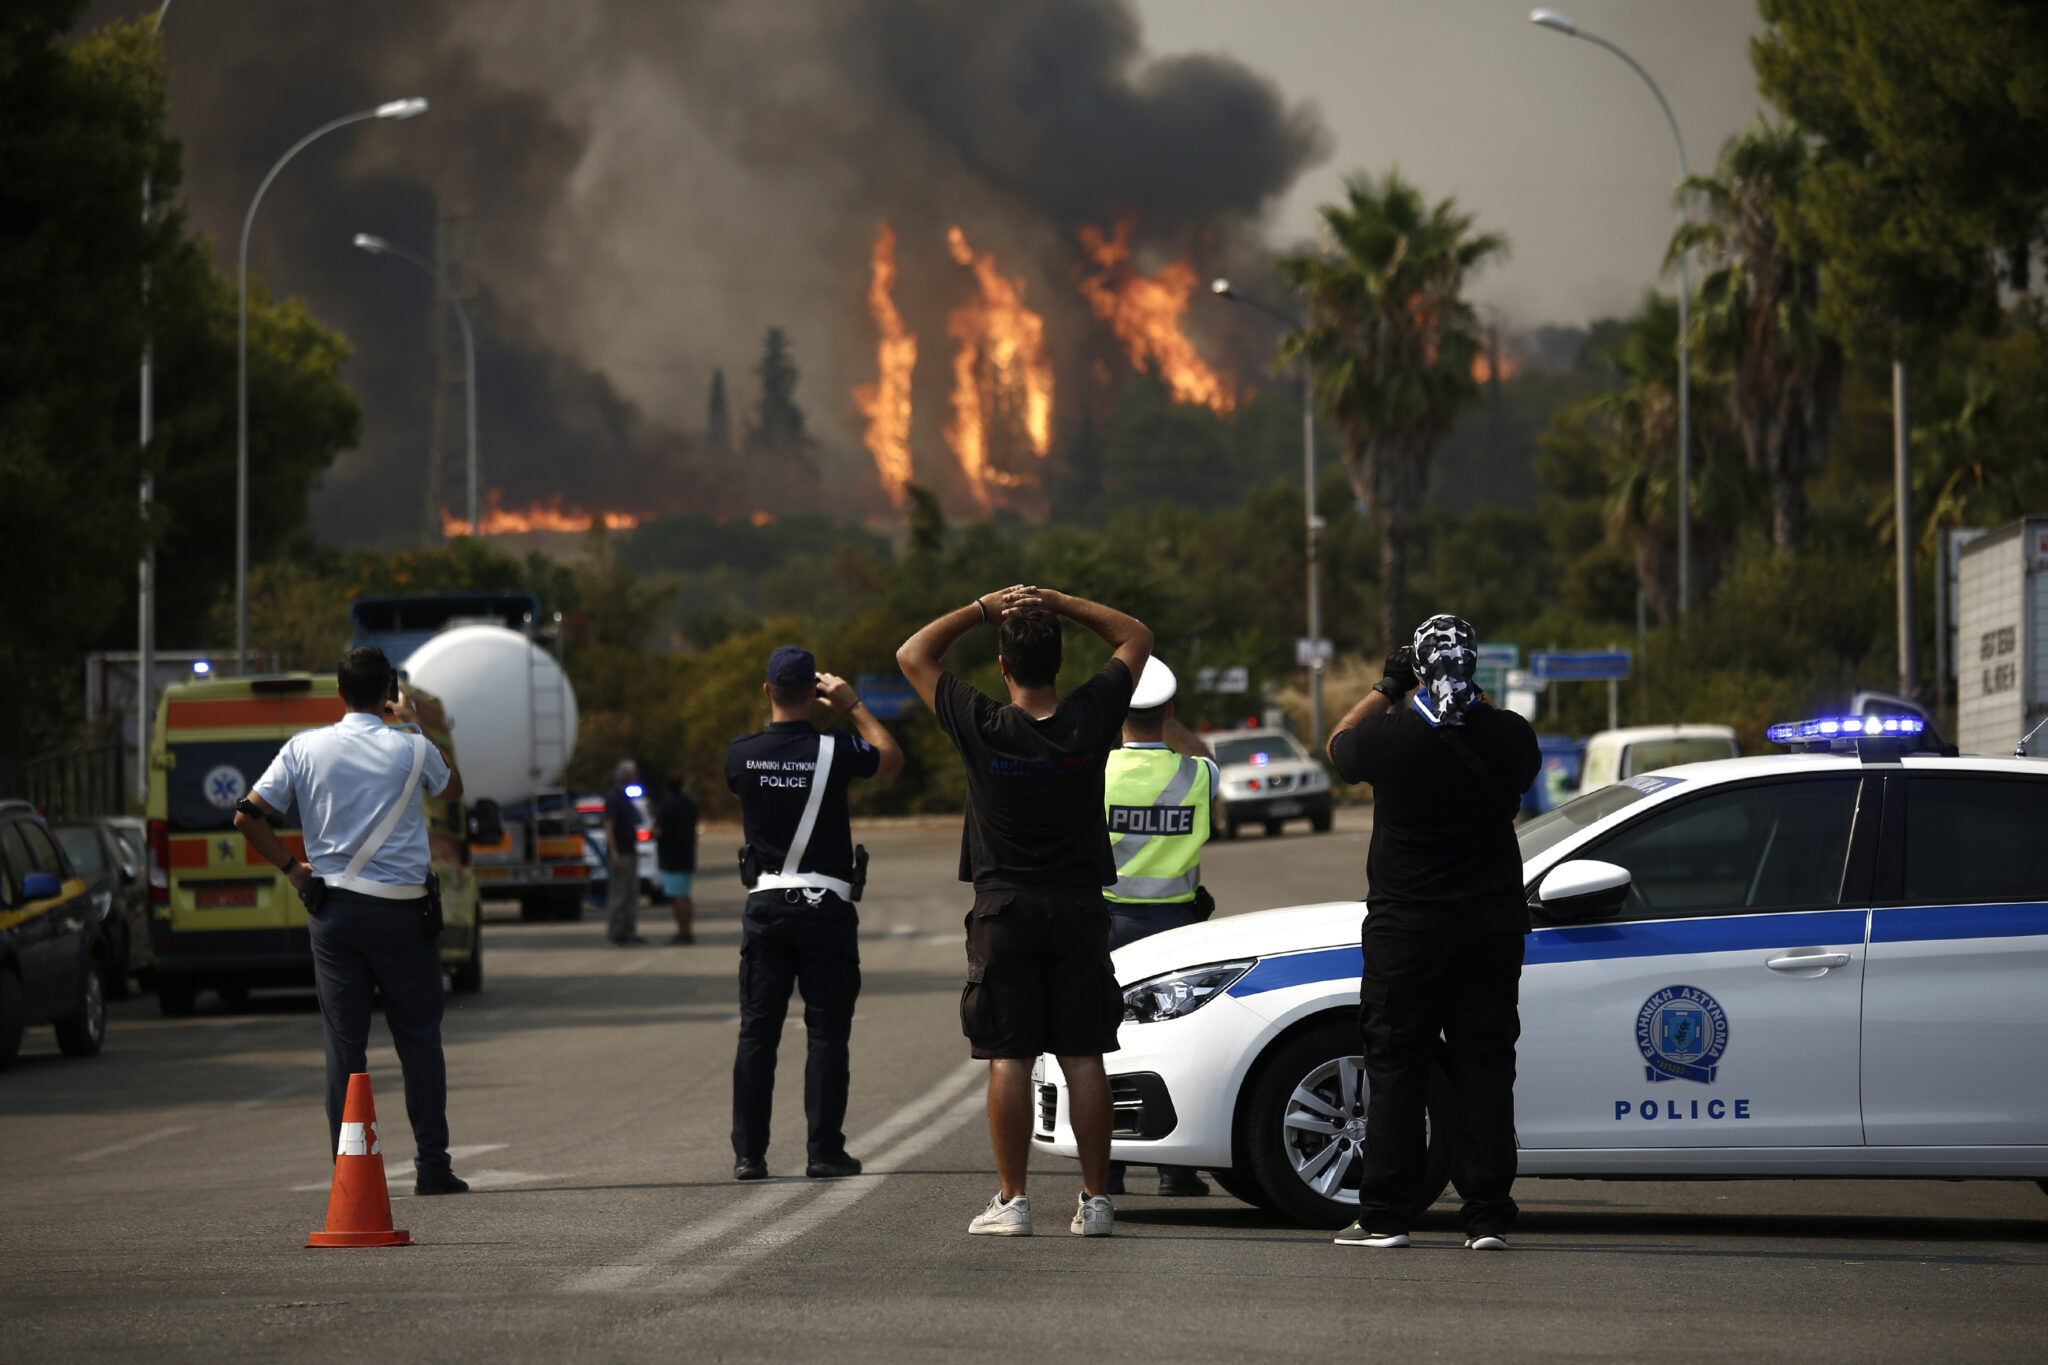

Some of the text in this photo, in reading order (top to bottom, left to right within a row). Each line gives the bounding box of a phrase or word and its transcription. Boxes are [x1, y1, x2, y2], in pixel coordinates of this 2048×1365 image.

[746, 760, 816, 771] ΕΛΛΗΝΙΚΗ ΑΣΤΥΝΟΜ
[760, 775, 807, 788] POLICE
[1112, 809, 1193, 831] POLICE
[1638, 988, 1727, 1058] ΕΛΛΗΝΙΚΗ ΑΣΤΥΝΟΜΙΑ
[1615, 1099, 1751, 1121] POLICE
